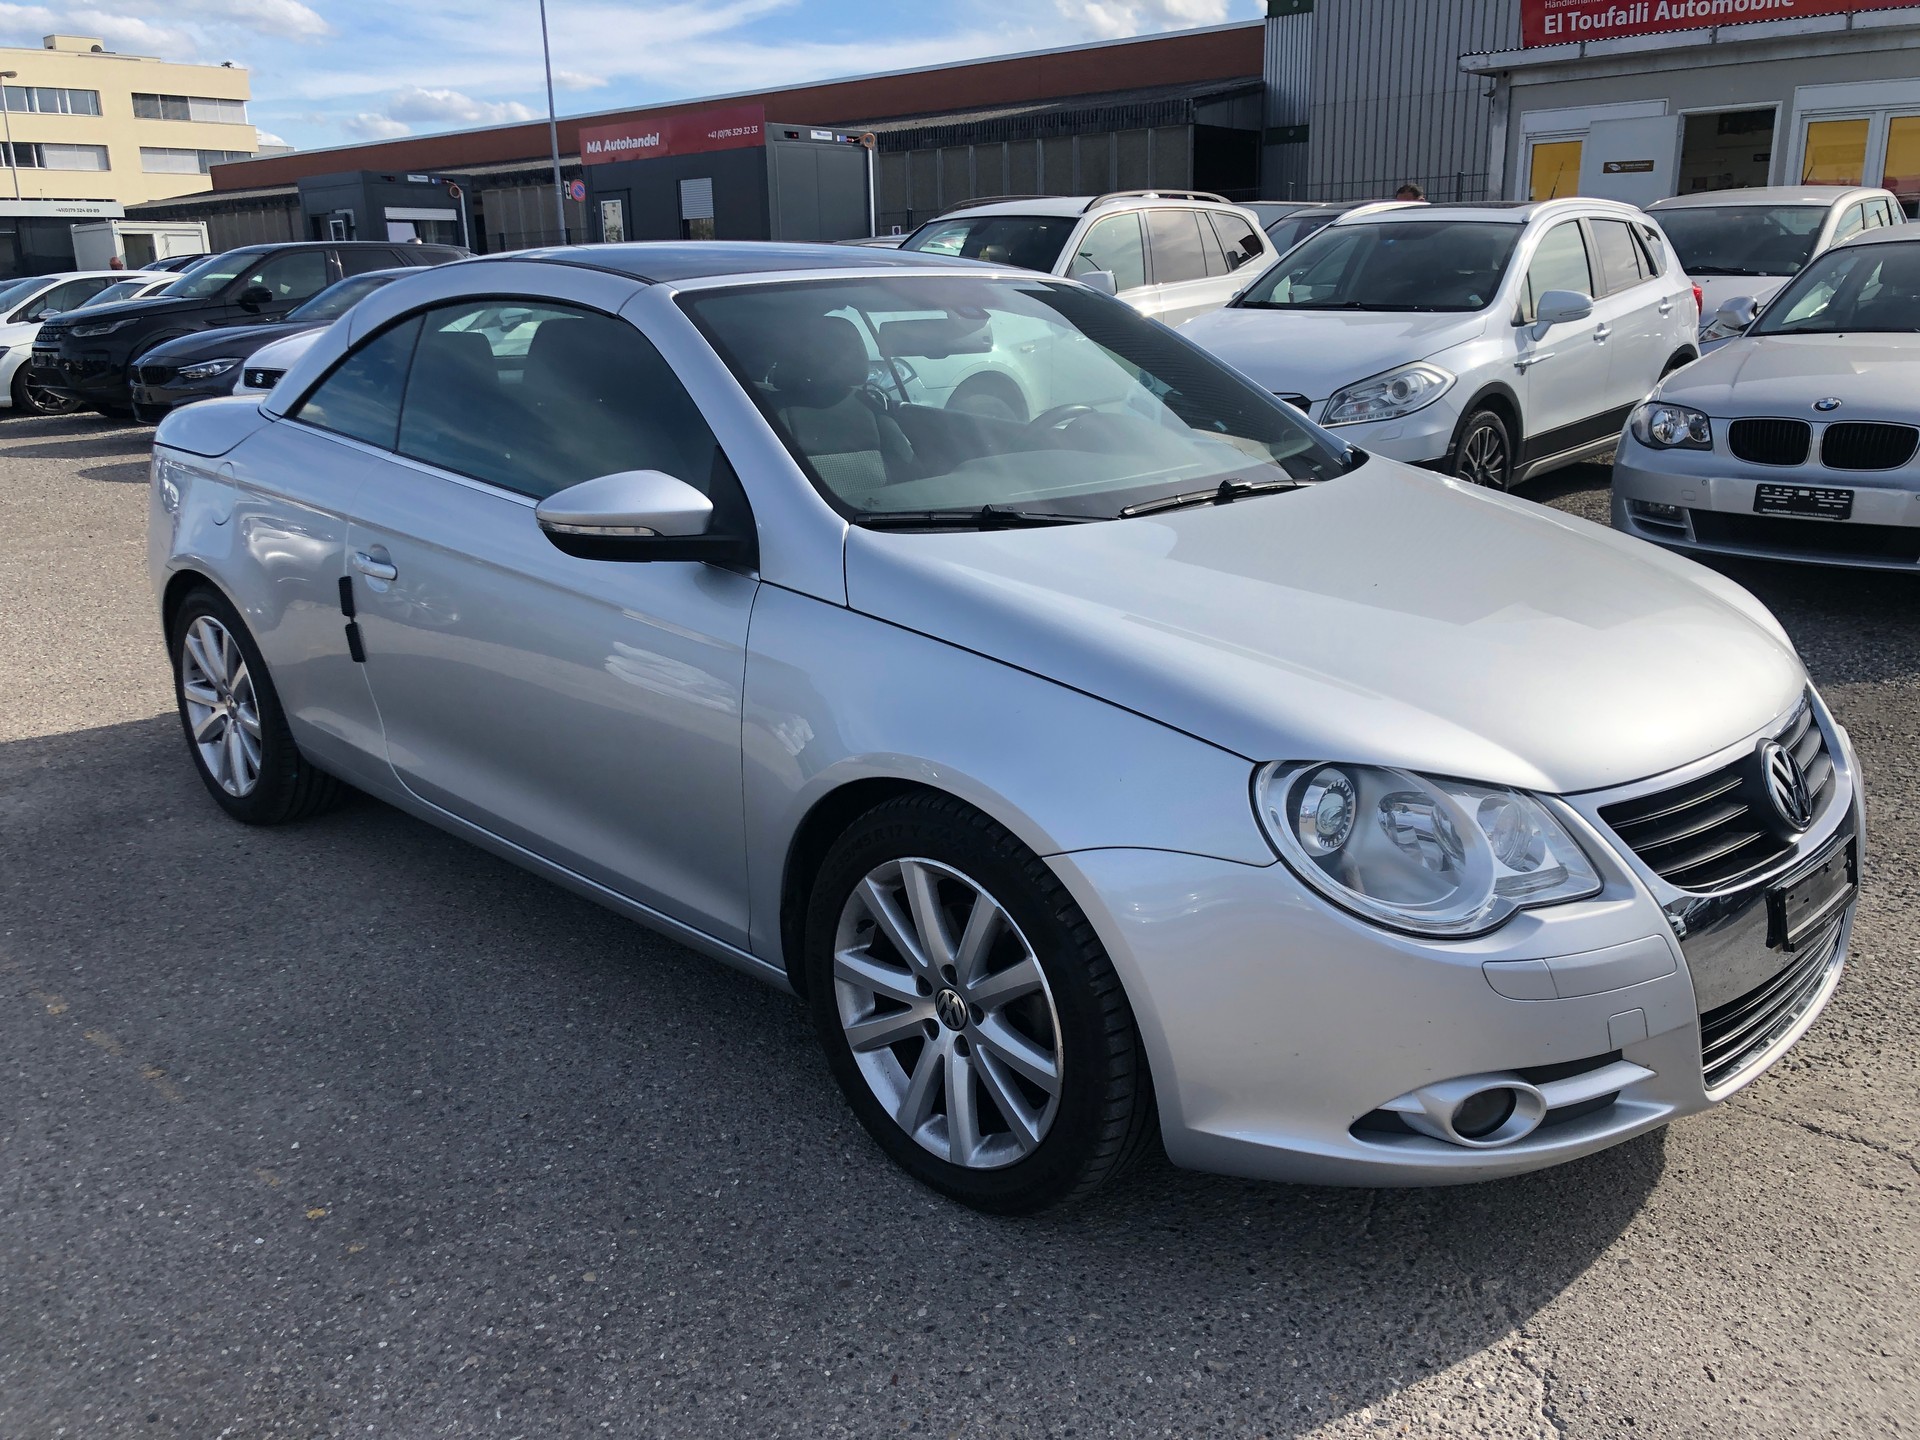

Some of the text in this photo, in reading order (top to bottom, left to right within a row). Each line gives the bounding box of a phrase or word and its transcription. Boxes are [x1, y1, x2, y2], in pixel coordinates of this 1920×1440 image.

[1544, 13, 1563, 35] El
[1567, 2, 1650, 32] Toufaili
[732, 127, 743, 136] 329
[743, 126, 751, 135] 32
[750, 125, 759, 134] 33
[586, 132, 660, 154] MA Autohandel
